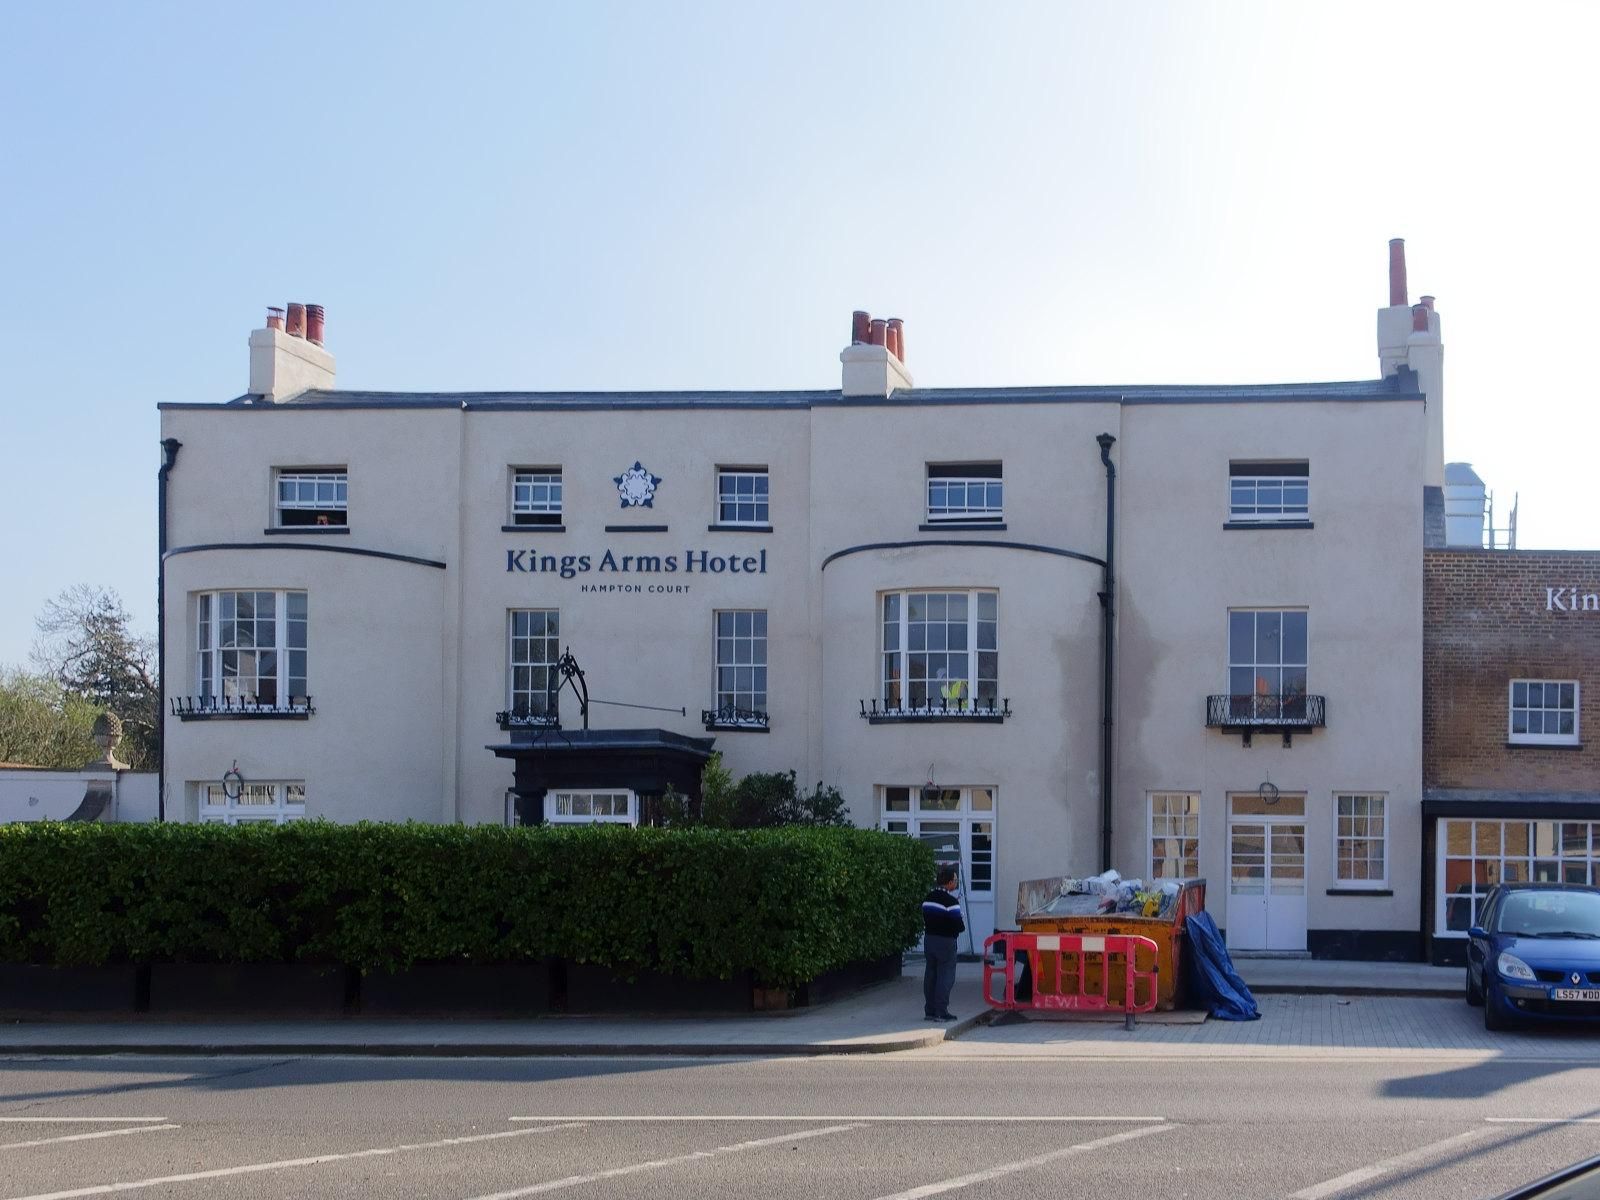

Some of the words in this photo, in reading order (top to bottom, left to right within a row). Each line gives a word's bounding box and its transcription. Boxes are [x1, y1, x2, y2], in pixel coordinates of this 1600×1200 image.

[506, 549, 591, 578] Kings
[598, 549, 677, 572] Arms
[685, 549, 767, 573] Hotel
[581, 584, 641, 593] HAMPTON
[648, 585, 690, 593] COURT
[1545, 587, 1600, 611] Kin
